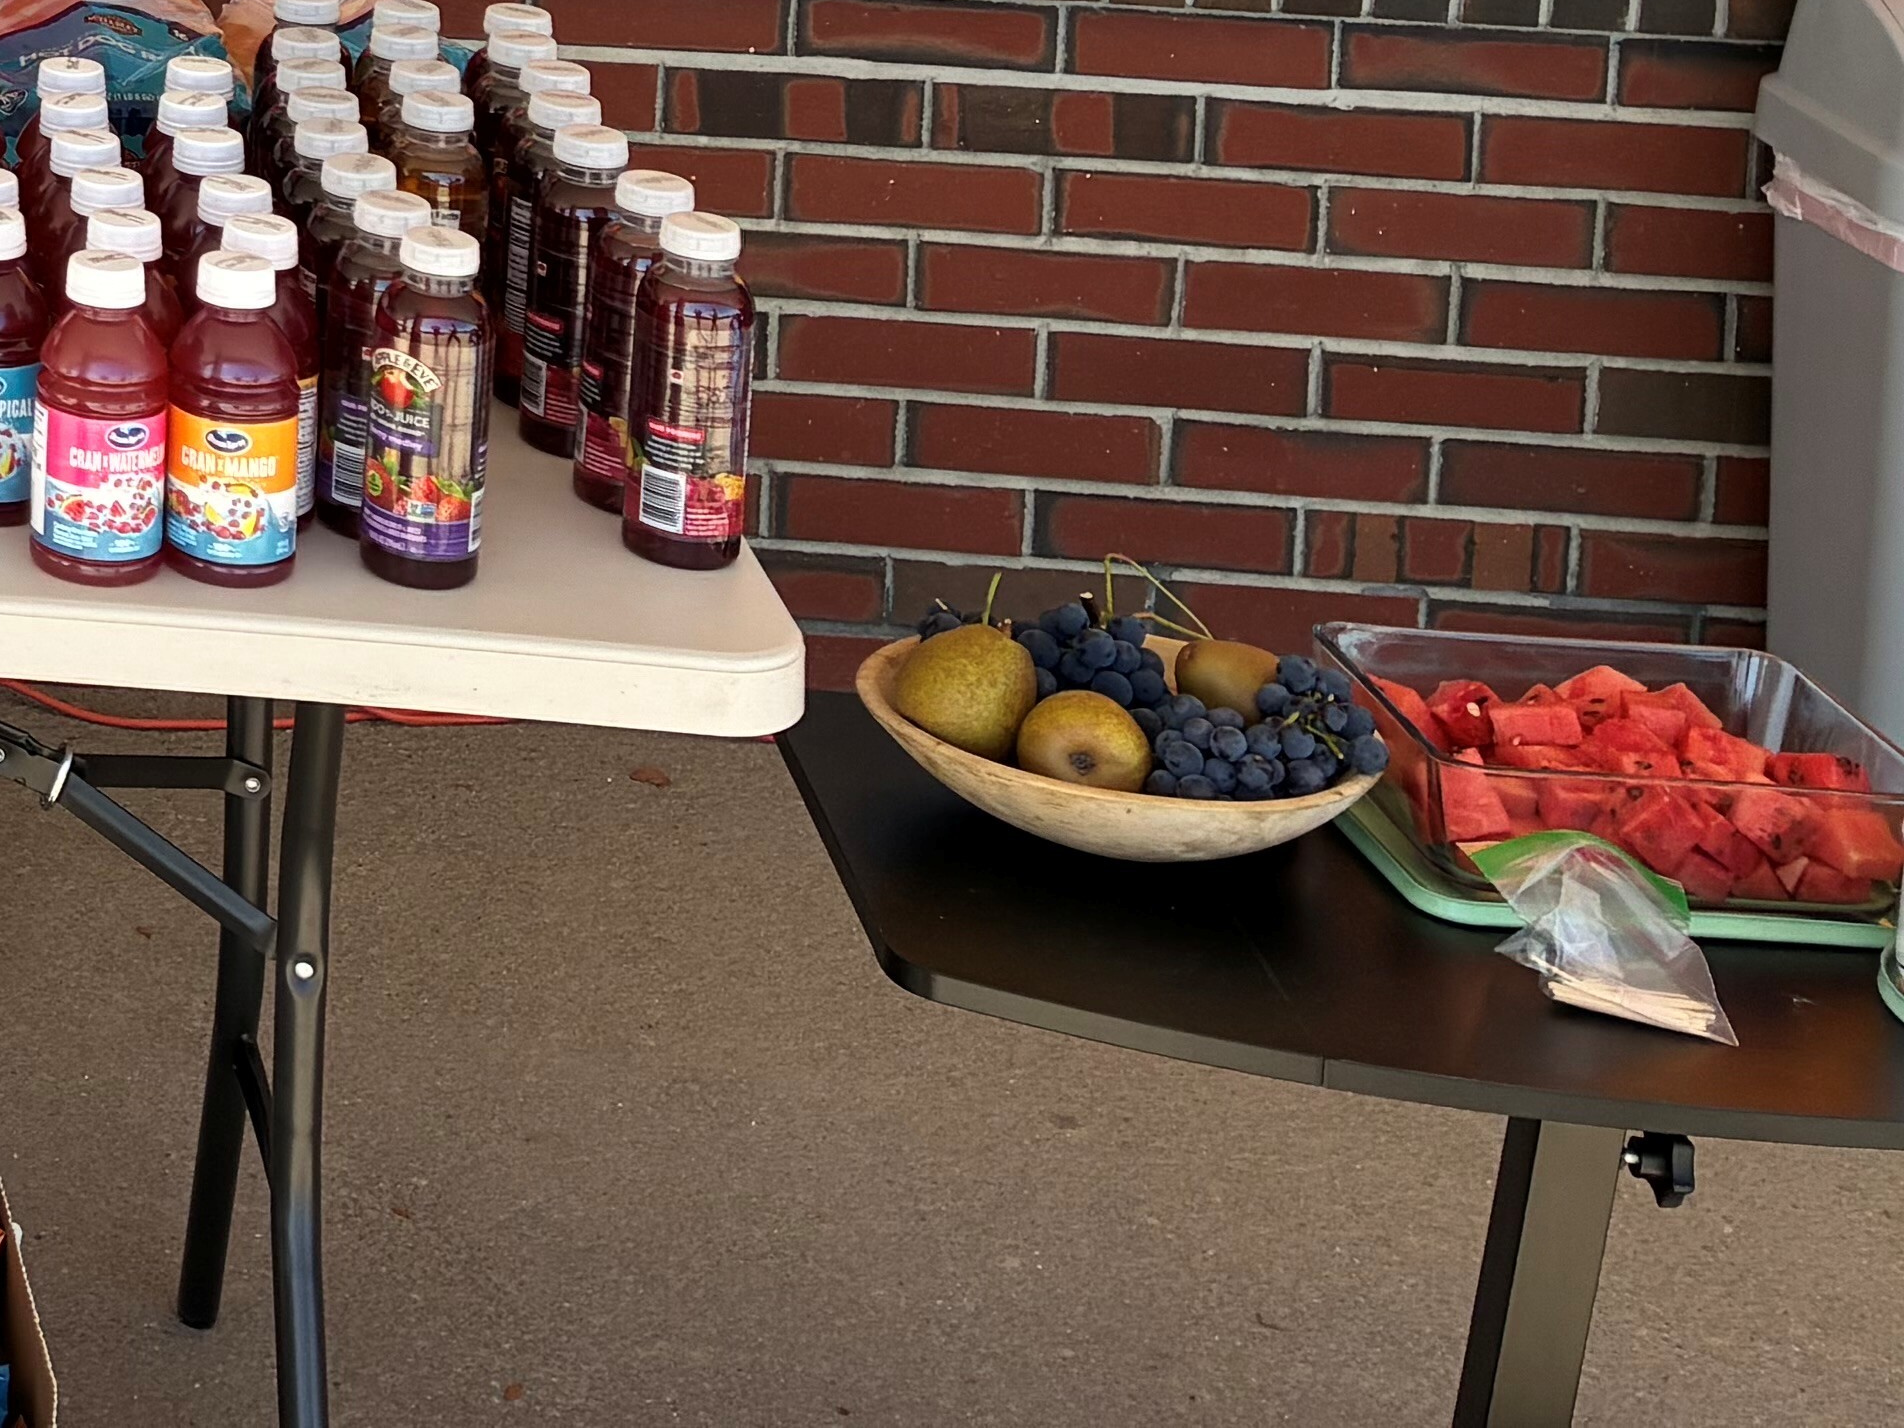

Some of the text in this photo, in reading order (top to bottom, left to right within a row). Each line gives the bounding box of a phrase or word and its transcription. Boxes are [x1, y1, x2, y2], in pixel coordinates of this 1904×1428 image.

[393, 411, 430, 429] JUICE
[69, 446, 103, 473] CRAN
[181, 444, 216, 475] CRAN
[224, 455, 277, 478] MANGO
